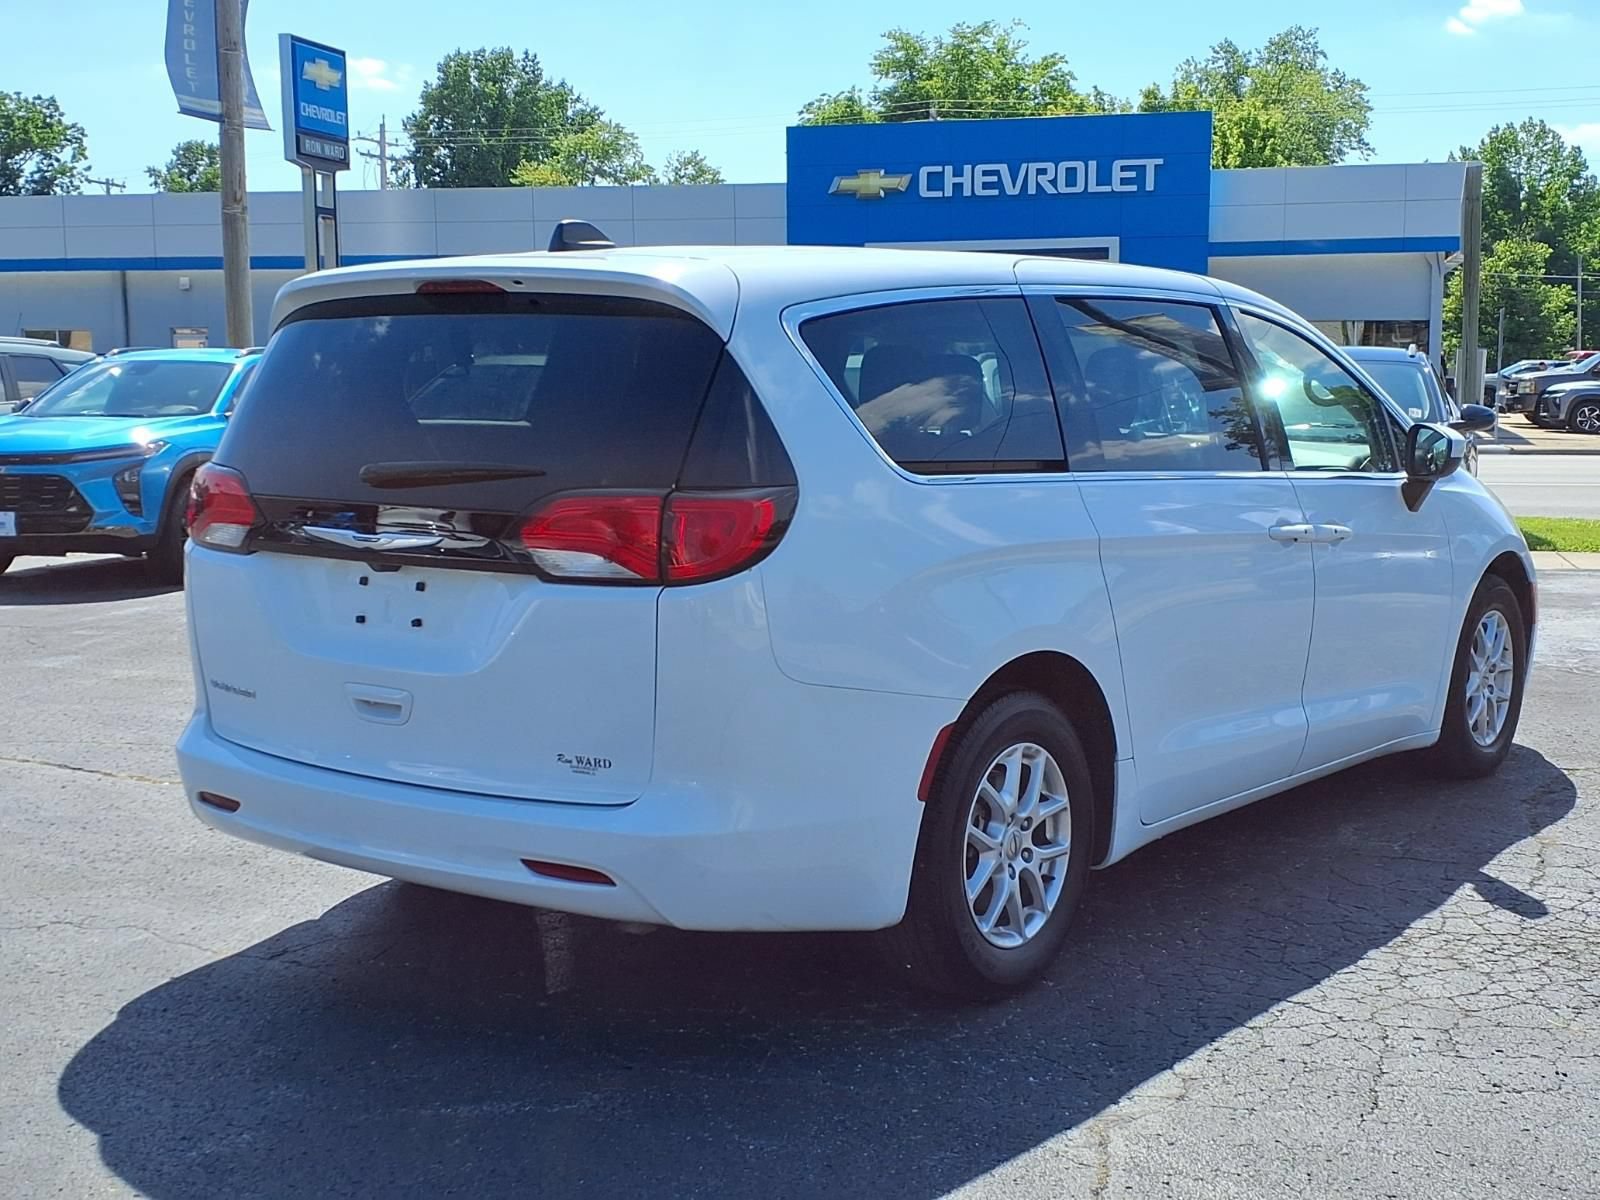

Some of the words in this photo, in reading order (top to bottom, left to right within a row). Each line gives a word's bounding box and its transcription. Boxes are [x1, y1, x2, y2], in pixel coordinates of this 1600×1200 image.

[300, 102, 346, 126] CHEVROLET
[305, 139, 321, 154] RON
[323, 143, 345, 160] WARD
[918, 158, 1164, 198] CHEVROLET
[575, 755, 612, 769] WARD
